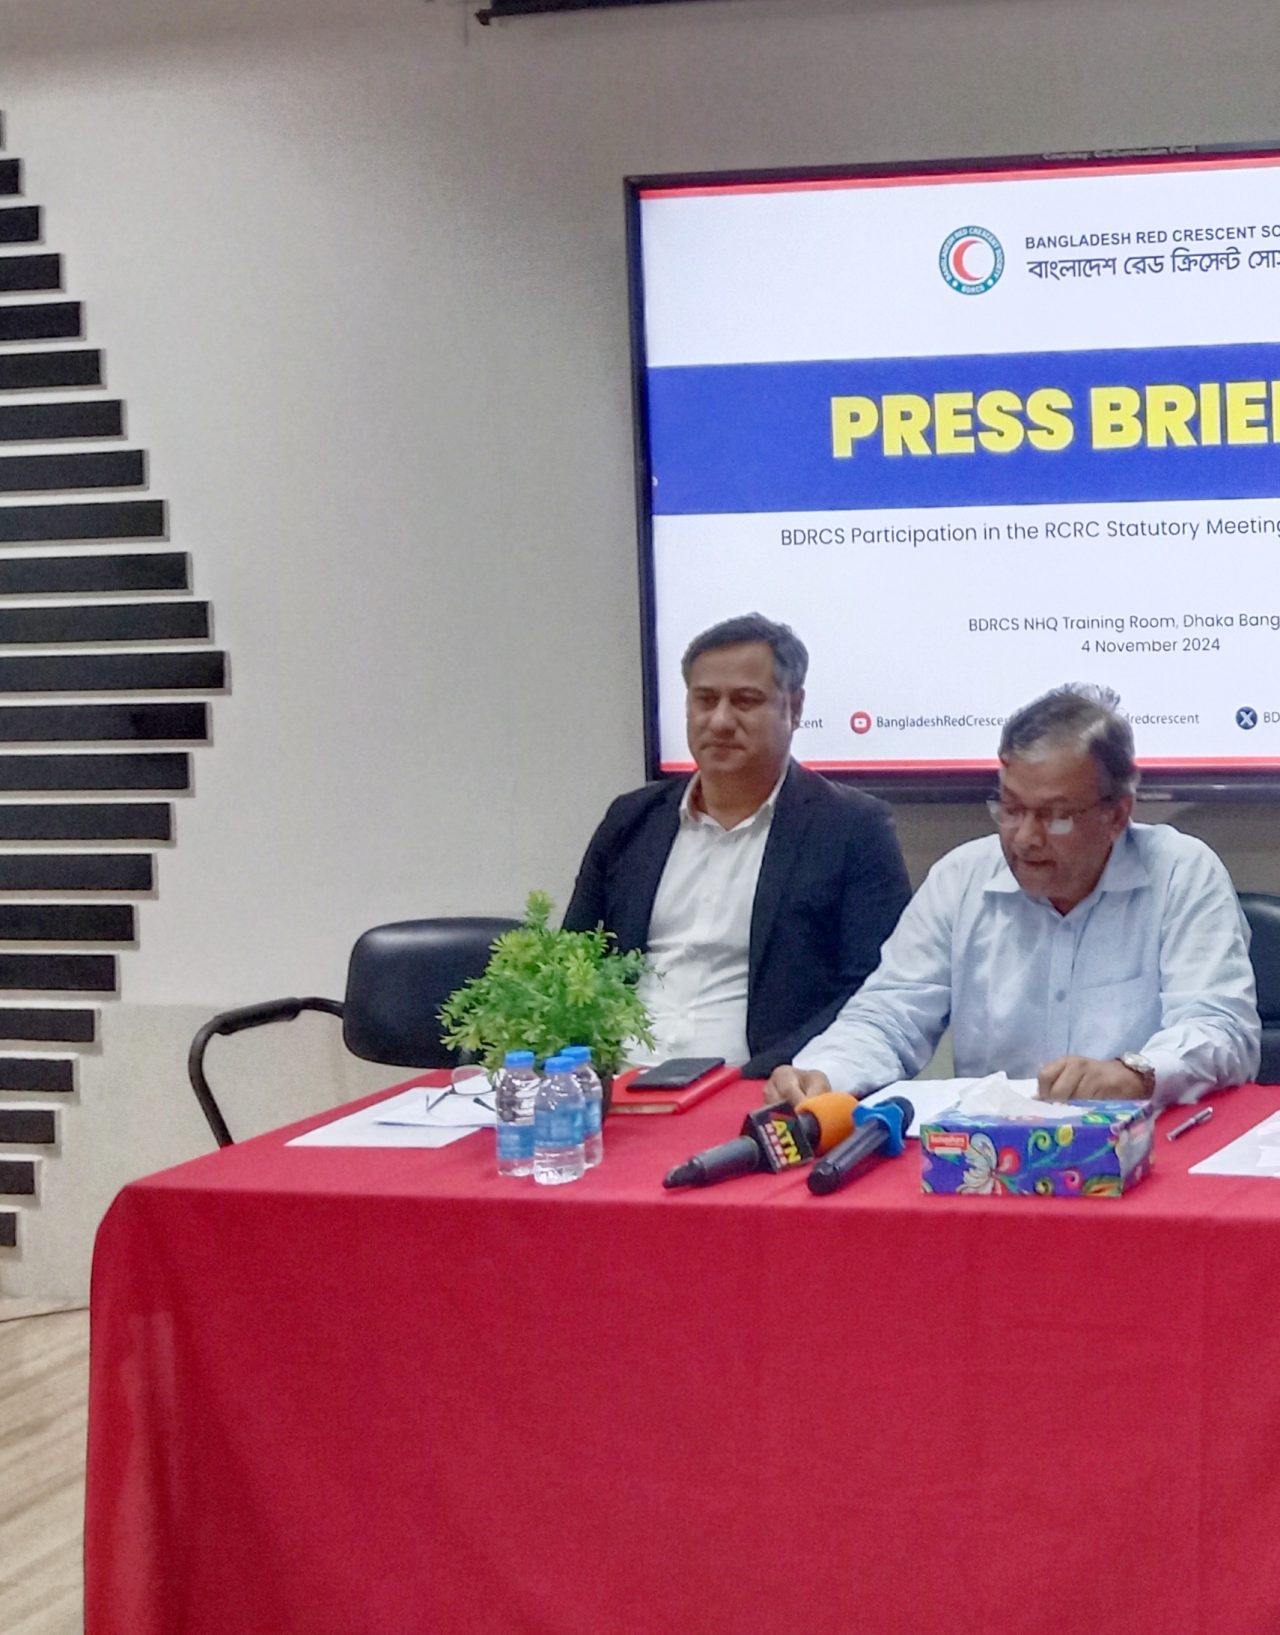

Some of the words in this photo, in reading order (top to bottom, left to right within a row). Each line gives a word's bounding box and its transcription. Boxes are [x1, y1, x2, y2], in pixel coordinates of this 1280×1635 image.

[1025, 232, 1132, 250] BANGLADESH
[1136, 230, 1168, 245] RED
[1172, 226, 1257, 243] CRESCENT
[1026, 256, 1118, 281] বাংলাদেশ
[1124, 254, 1166, 276] রেড
[1170, 246, 1242, 274] ক্রিসেন্ট
[831, 388, 1074, 458] PRESS
[780, 527, 846, 546] BDRCS
[851, 523, 978, 549] Participation
[983, 520, 1001, 541] in
[1006, 521, 1039, 540] the
[1045, 520, 1100, 539] RCRC
[1106, 518, 1200, 541] Statutory
[968, 617, 1020, 632] BDRCS
[1024, 616, 1059, 633] NHQ
[1062, 615, 1125, 633] Training
[1130, 614, 1180, 631] Room,
[1183, 613, 1235, 629] Dhaka
[1080, 639, 1091, 653] 4
[1095, 638, 1178, 653] November
[1182, 637, 1221, 652] 2024
[770, 1120, 802, 1164] ATN
